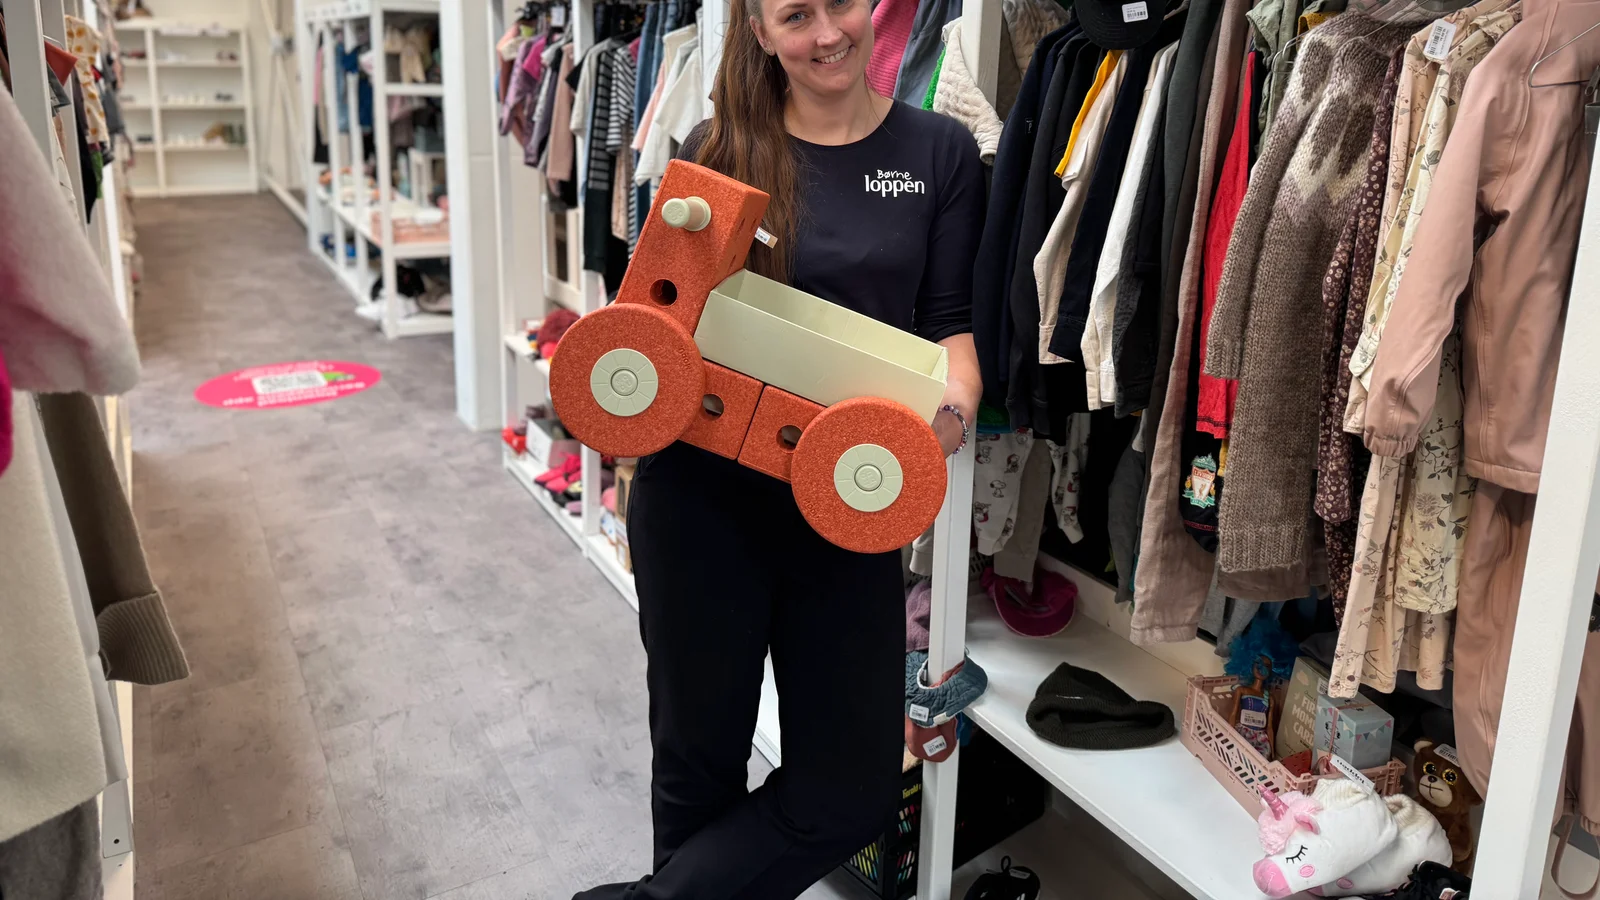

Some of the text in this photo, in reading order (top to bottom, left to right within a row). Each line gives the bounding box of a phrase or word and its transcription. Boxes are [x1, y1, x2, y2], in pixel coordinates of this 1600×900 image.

[876, 169, 912, 180] Børne
[864, 174, 925, 198] loppen
[1301, 696, 1317, 716] FIR
